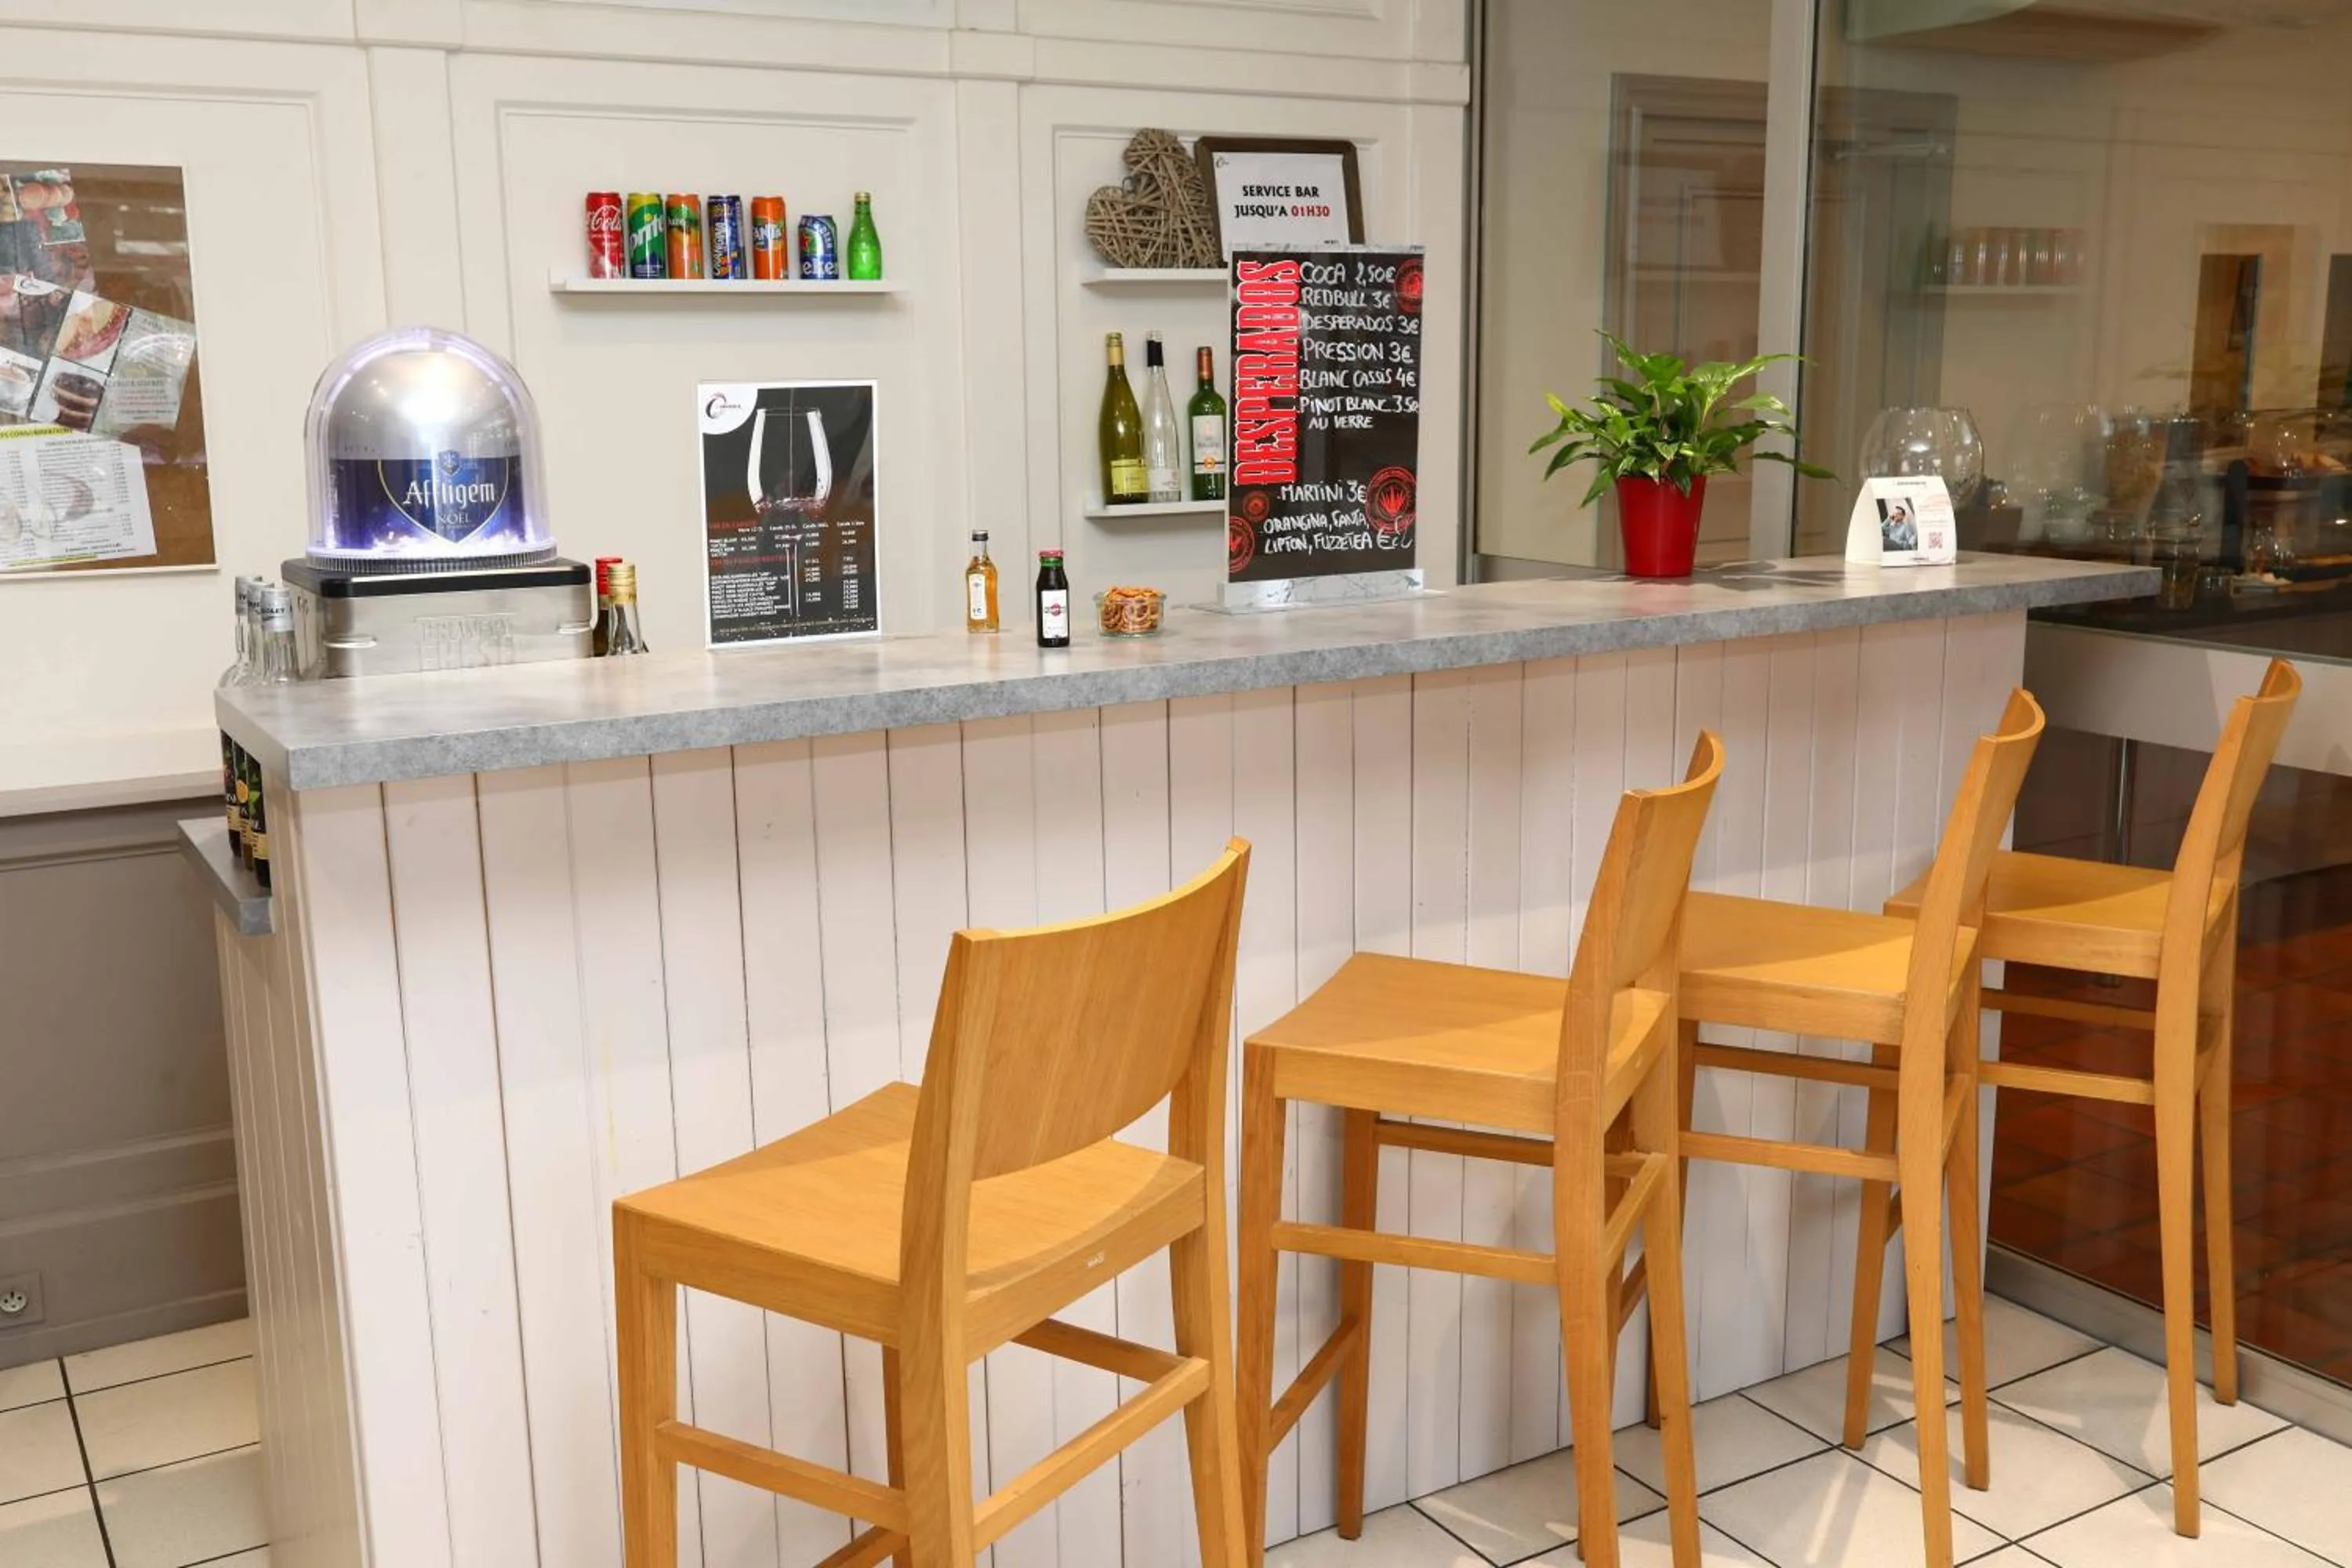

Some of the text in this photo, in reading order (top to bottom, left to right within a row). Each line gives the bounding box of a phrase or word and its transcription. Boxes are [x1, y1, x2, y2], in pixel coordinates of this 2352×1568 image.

[1242, 185, 1320, 198] SERVICE BAR
[1234, 205, 1331, 218] JUSQU'A 01H30
[1300, 261, 1346, 285] COCA
[1301, 287, 1392, 309] REDBULL 3€
[1398, 315, 1420, 335] 3€
[1388, 341, 1414, 364] 3€
[1234, 260, 1299, 486] DESPERADOS
[1300, 368, 1349, 390] BLANC
[1396, 367, 1417, 387] 4€
[1308, 415, 1374, 430] AU VERRE
[401, 479, 495, 510] Afligem
[1347, 479, 1367, 503] 3€
